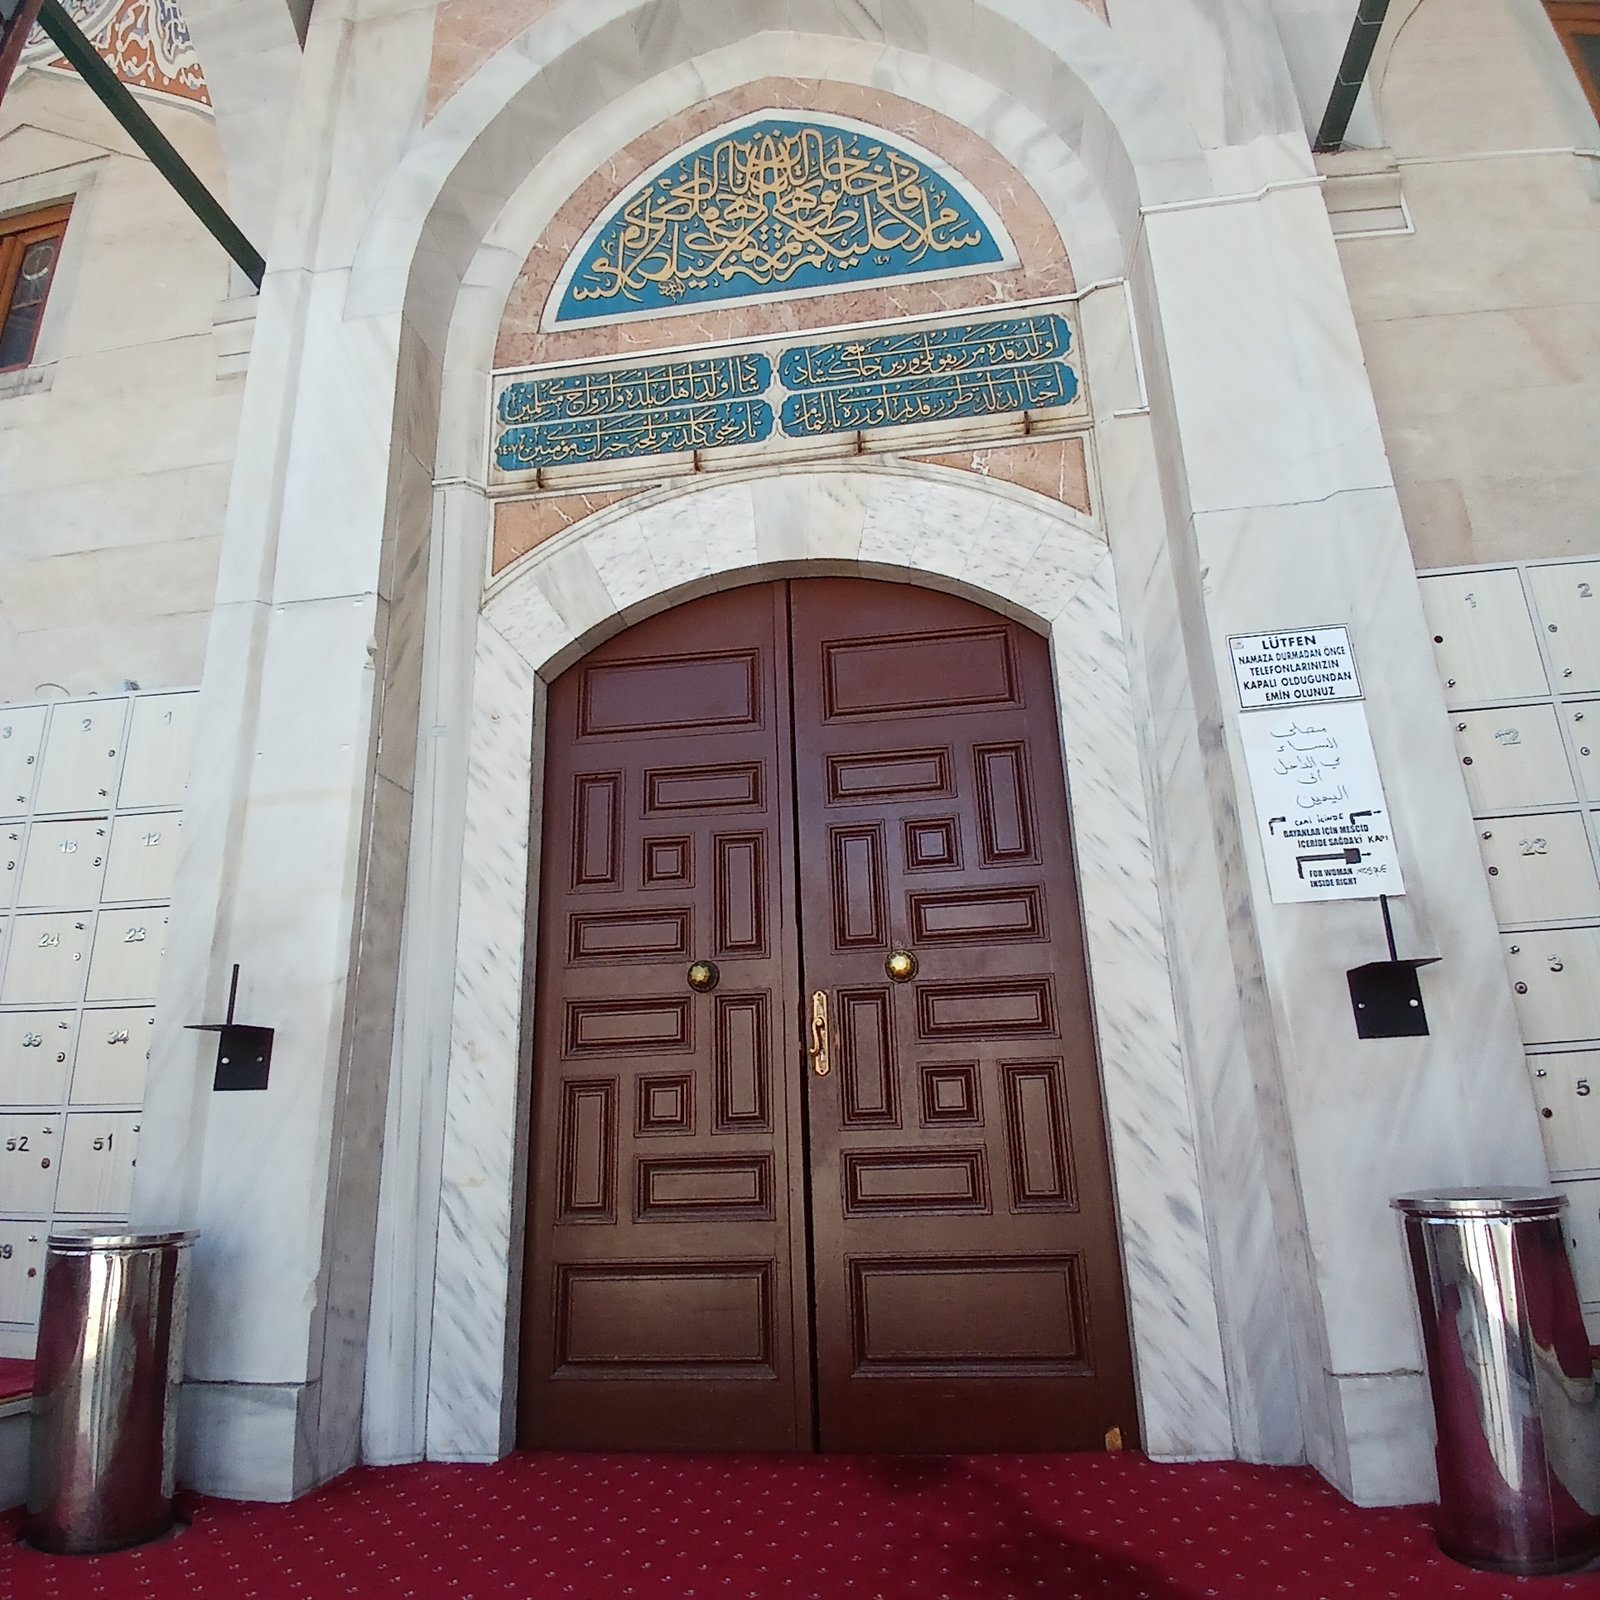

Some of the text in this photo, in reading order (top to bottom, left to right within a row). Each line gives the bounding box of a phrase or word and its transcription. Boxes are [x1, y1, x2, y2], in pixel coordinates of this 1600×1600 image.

[1577, 582, 1593, 598] 2
[1261, 635, 1317, 650] LÜTFEN
[1238, 653, 1274, 665] NAMAZA
[1275, 648, 1321, 662] DURMADAN
[1249, 659, 1340, 677] TELEFONLARINIZIN
[1243, 678, 1277, 691] KAPALI
[1265, 686, 1336, 701] EMİN OLUNUZ
[163, 711, 173, 724] 1
[2, 726, 13, 739] 3
[81, 719, 92, 732] 2
[142, 832, 161, 846] 12
[1283, 828, 1321, 838] BAYANLAR
[1322, 826, 1339, 836] İÇİN
[1309, 869, 1324, 878] FOR
[1324, 867, 1353, 877] WOMAN
[1309, 877, 1357, 888] INSIDE RIGHT
[37, 933, 60, 948] 24
[123, 927, 146, 943] 23
[22, 1032, 43, 1048] 35
[106, 1028, 129, 1045] 34
[6, 1136, 30, 1152] 52
[92, 1133, 114, 1152] 51
[0, 1244, 13, 1260] 9
